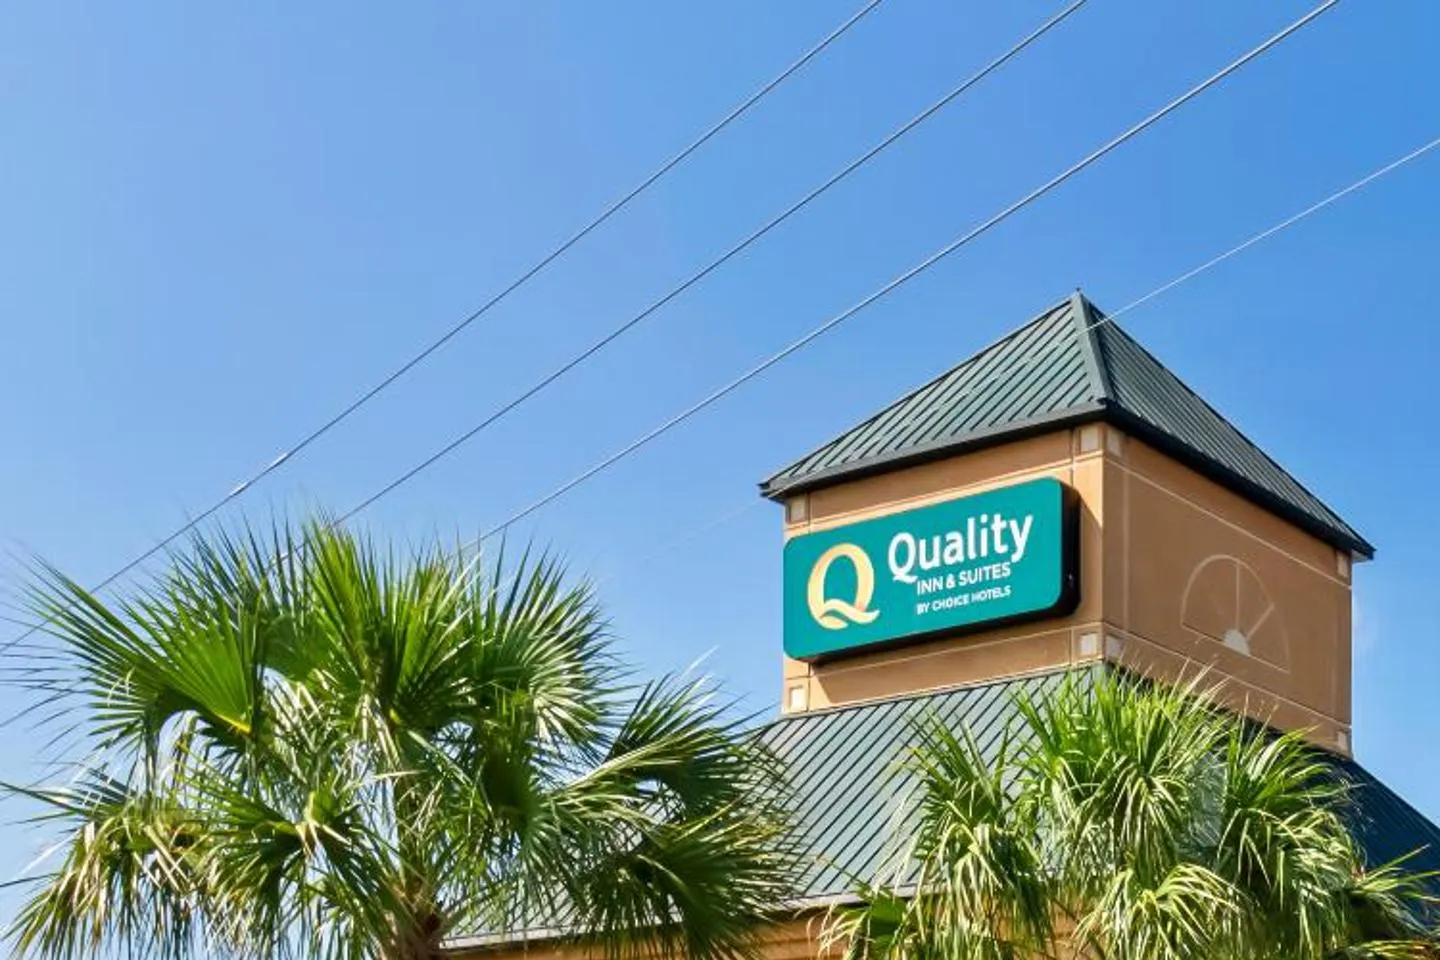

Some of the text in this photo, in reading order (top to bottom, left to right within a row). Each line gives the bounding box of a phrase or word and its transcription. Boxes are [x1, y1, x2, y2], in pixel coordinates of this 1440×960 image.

[888, 513, 1034, 583] Quality
[807, 543, 880, 630] Q
[916, 585, 1012, 615] BY CHOICE HOTELS
[917, 561, 1011, 595] INN & SUITES
